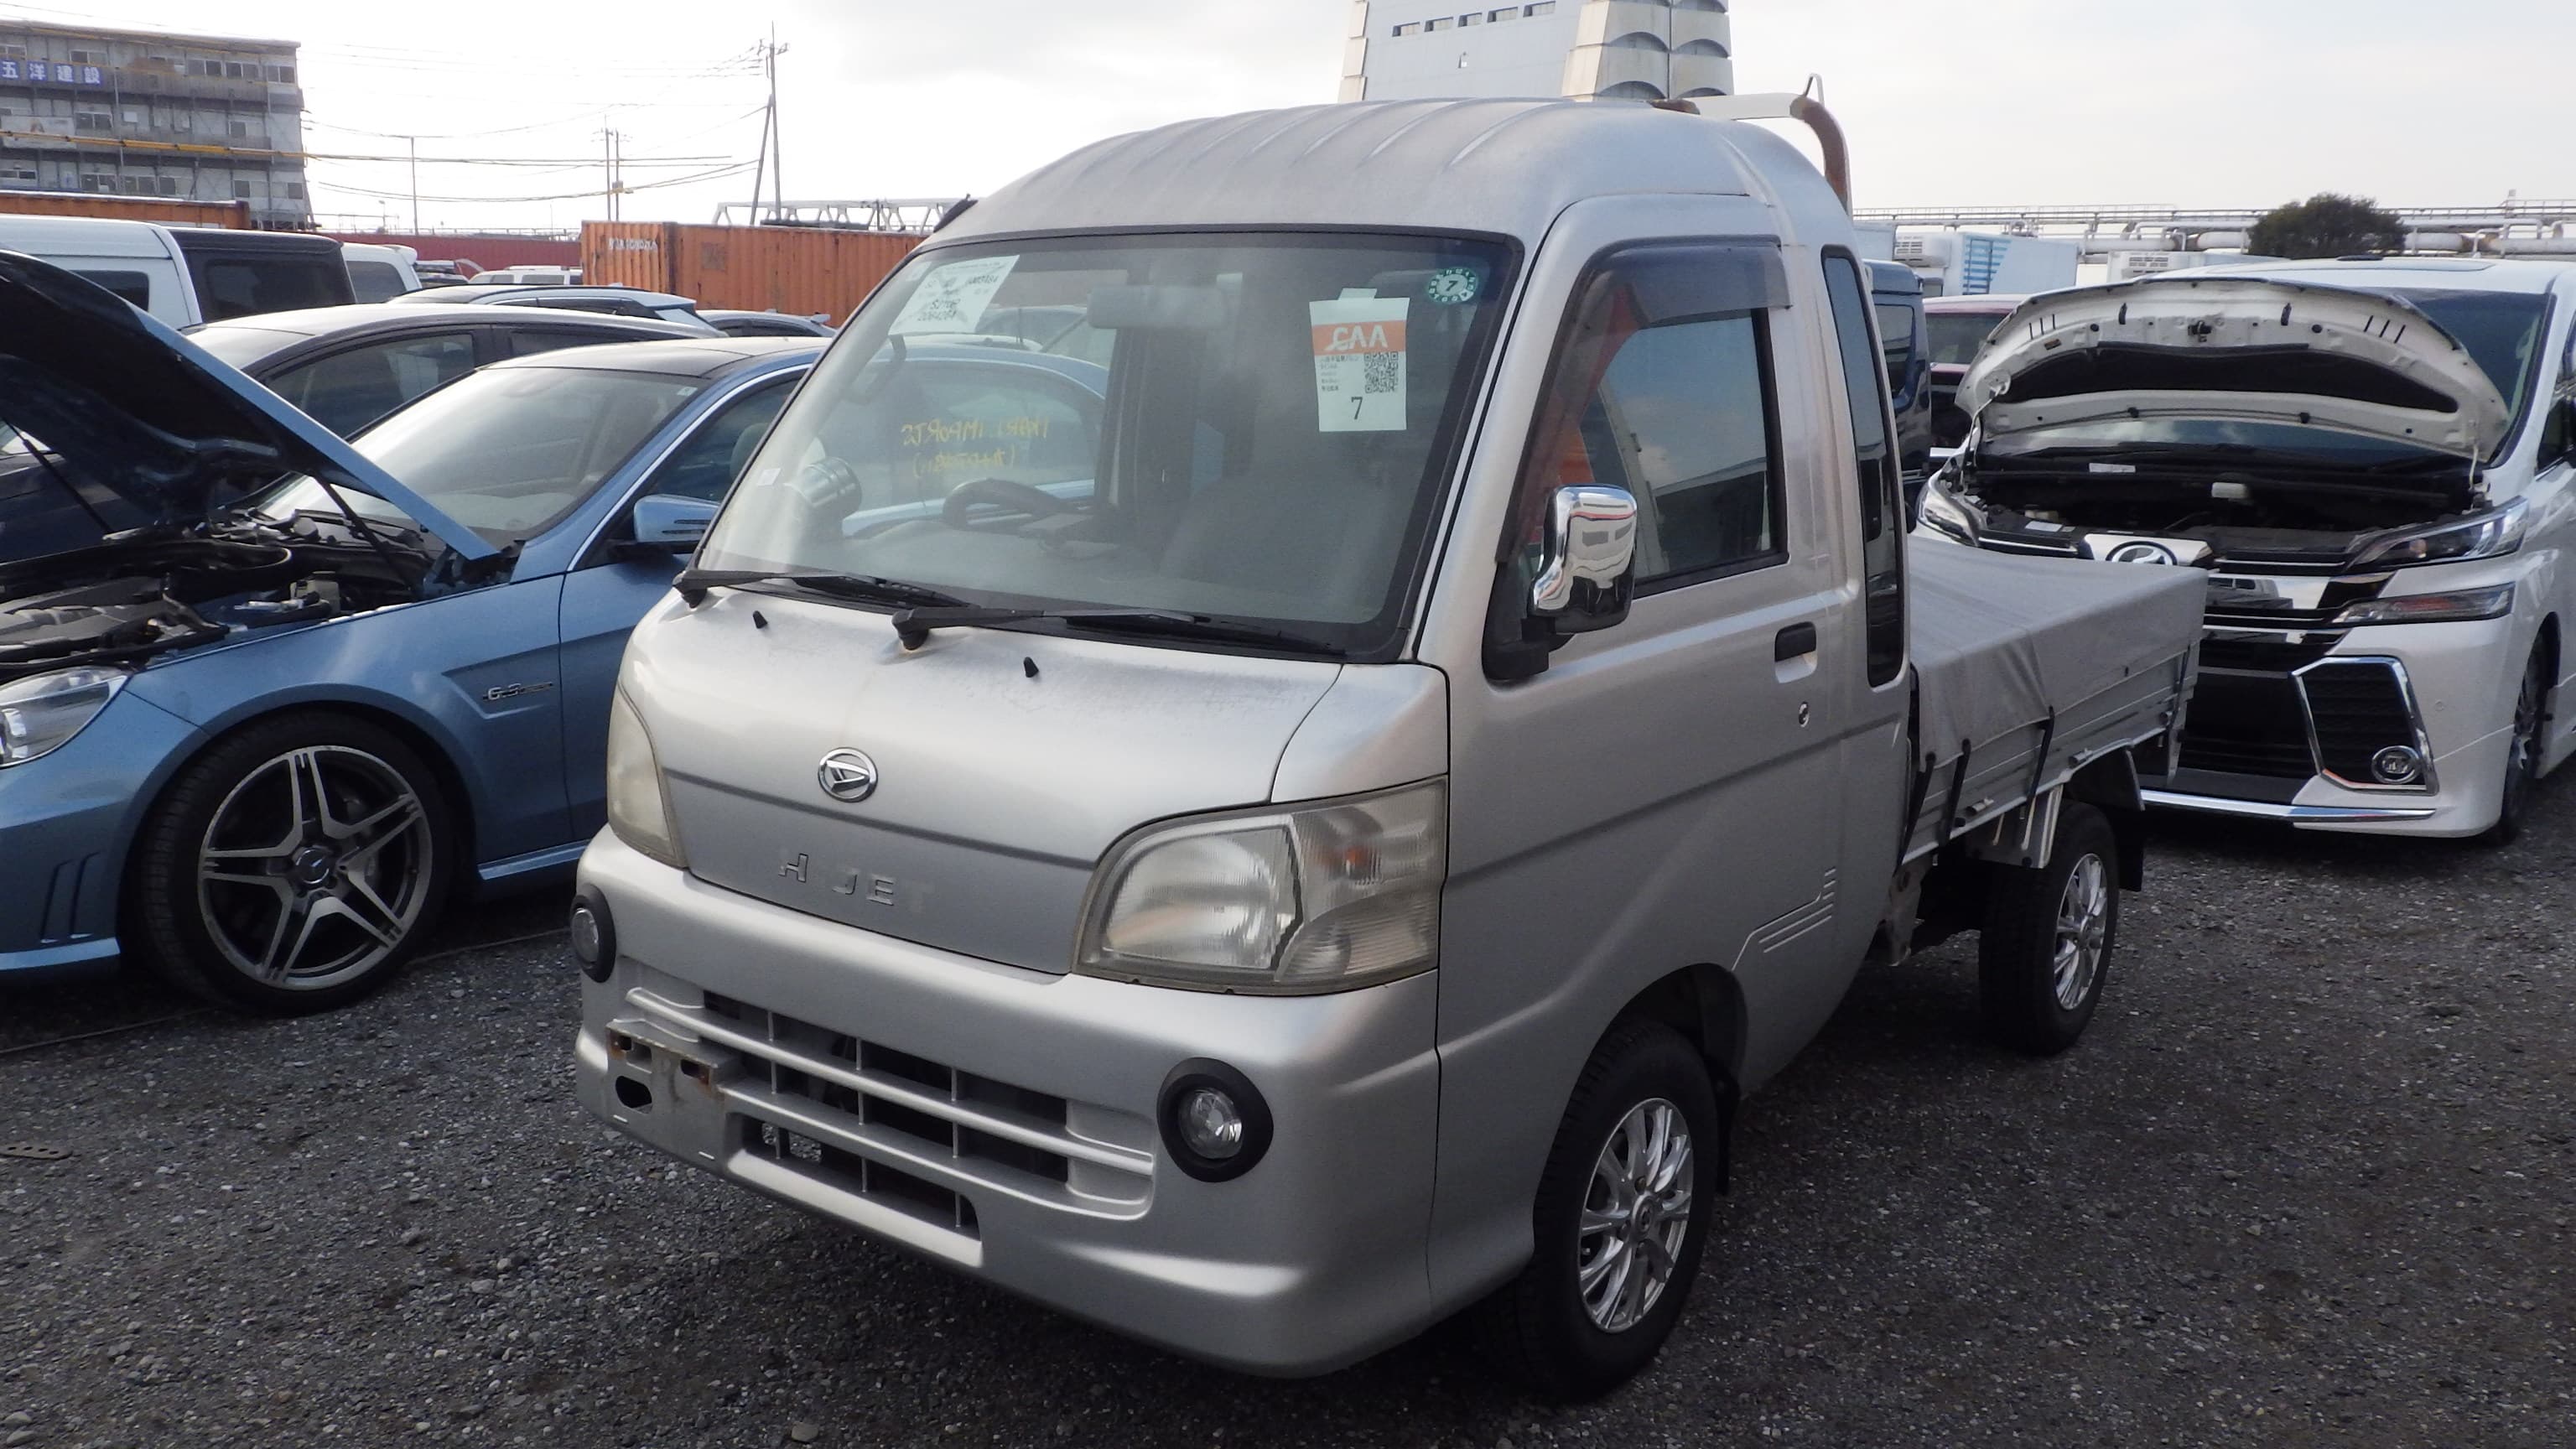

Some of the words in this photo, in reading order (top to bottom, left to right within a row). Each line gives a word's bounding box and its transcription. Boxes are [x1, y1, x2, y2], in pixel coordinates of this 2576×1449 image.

[1445, 280, 1459, 292] 7
[1323, 324, 1389, 351] CAA
[1351, 396, 1363, 420] 7
